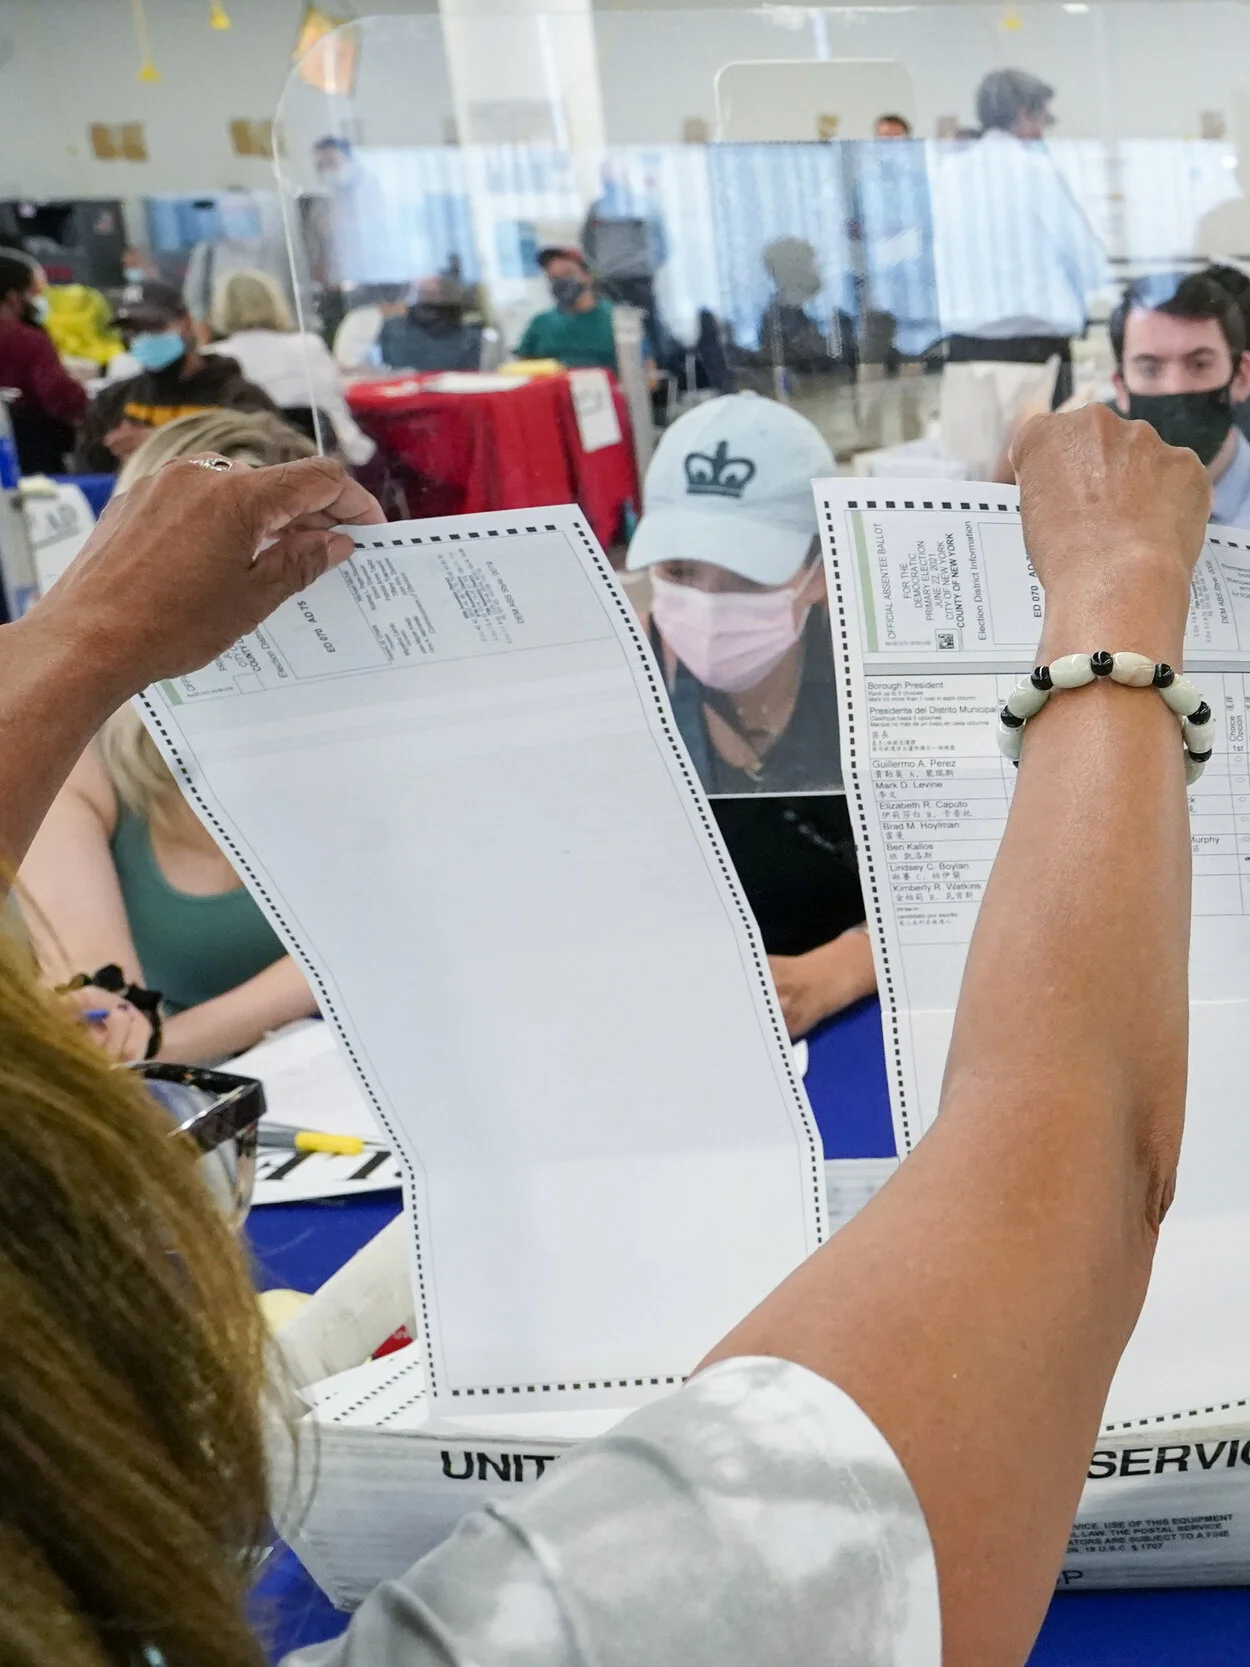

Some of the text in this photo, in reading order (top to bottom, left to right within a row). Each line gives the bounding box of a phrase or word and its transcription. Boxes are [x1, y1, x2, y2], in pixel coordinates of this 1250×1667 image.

[929, 553, 938, 571] 2021
[873, 523, 896, 639] OFFICIAL ABSENTEE BALLOT
[899, 563, 911, 599] FOR THE
[908, 553, 923, 608] DEMOCRATIC
[917, 540, 935, 621] PRIMARY ELECTION
[937, 542, 954, 620] CITY OF NEW YORK
[945, 533, 965, 628] COUNTY OF NEW YORK
[965, 521, 987, 641] Election District Information
[932, 587, 943, 608] JUNE
[1031, 585, 1040, 602] 070
[304, 611, 317, 623] AD
[1033, 604, 1042, 618] ED
[323, 642, 336, 653] ED
[867, 681, 944, 691] Borough President
[960, 705, 997, 714] Municipal
[872, 760, 915, 768] Guillermo
[930, 759, 956, 767] Perez
[876, 781, 898, 789] Mark
[913, 780, 943, 788] Levine
[880, 801, 920, 809] Elizabeth
[936, 801, 968, 809] Caputo
[883, 822, 904, 830] Brad
[920, 821, 960, 831] Hoylman
[887, 843, 904, 851] Ben
[890, 864, 923, 872] Lindsey
[939, 863, 969, 871] Boylan
[893, 884, 931, 892] Kimberly
[946, 882, 981, 890] Watkins
[441, 1450, 558, 1482] UNIT
[1129, 1520, 1142, 1528] OF
[1147, 1518, 1169, 1527] THIS
[1172, 1514, 1233, 1525] EQUIPMENT
[1111, 1529, 1131, 1537] THE
[1133, 1526, 1173, 1535] POSTAL
[1177, 1523, 1222, 1532] SERVICE
[1105, 1537, 1125, 1545] ARE
[1129, 1533, 1177, 1543] SUBJECT
[1207, 1530, 1230, 1538] FINE
